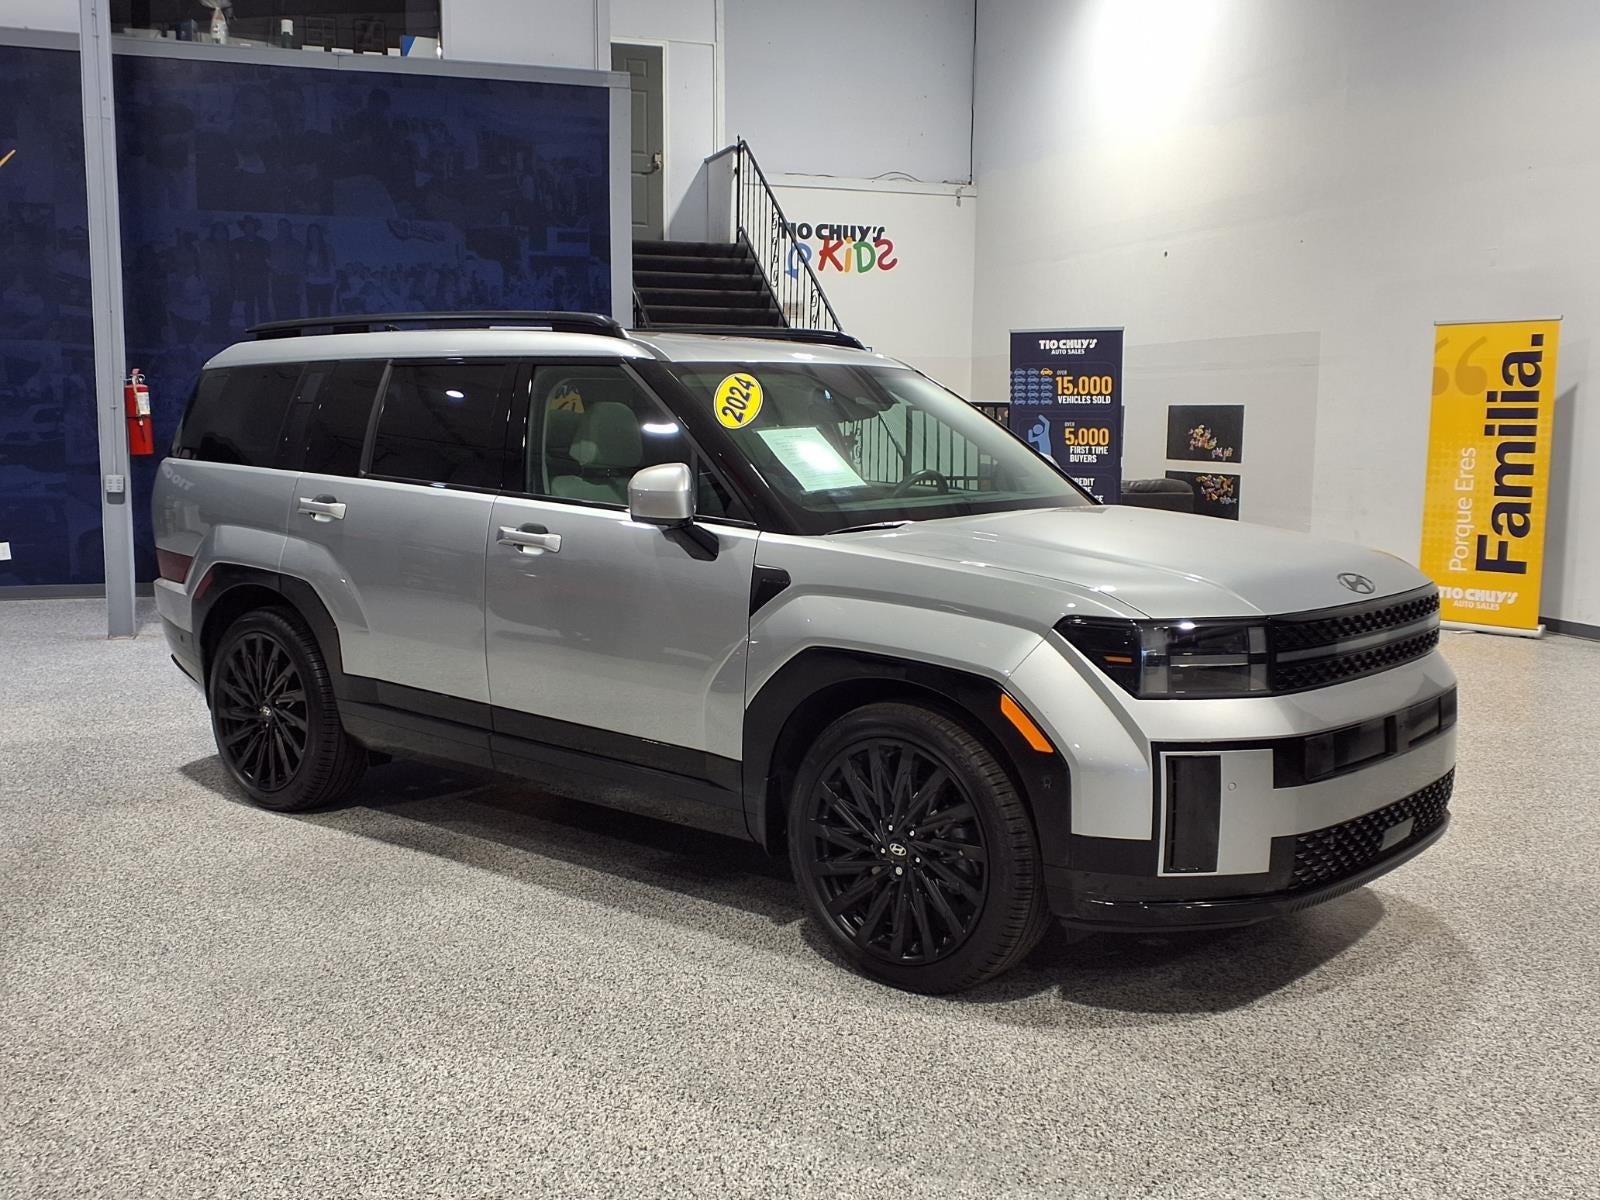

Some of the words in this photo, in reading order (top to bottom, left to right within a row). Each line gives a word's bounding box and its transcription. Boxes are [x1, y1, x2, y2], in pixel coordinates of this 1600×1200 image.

[1038, 339, 1059, 350] TIO
[1059, 338, 1098, 349] CHUY'S
[1056, 375, 1112, 395] 15,000
[722, 376, 755, 424] 2024
[1057, 395, 1091, 404] VEHICLES
[1092, 395, 1111, 404] SOLD
[1065, 427, 1109, 446] 5,000
[1069, 446, 1090, 455] FIRST
[1092, 446, 1109, 455] TIME
[1069, 455, 1097, 463] BUYERS
[1475, 333, 1544, 575] Familia.
[1455, 447, 1476, 491] Eres
[1448, 496, 1475, 572] Porque
[1438, 585, 1464, 600] TIO
[1464, 588, 1519, 605] CHUY'S
[1453, 600, 1475, 609] AUTO
[1475, 601, 1500, 611] SALES
